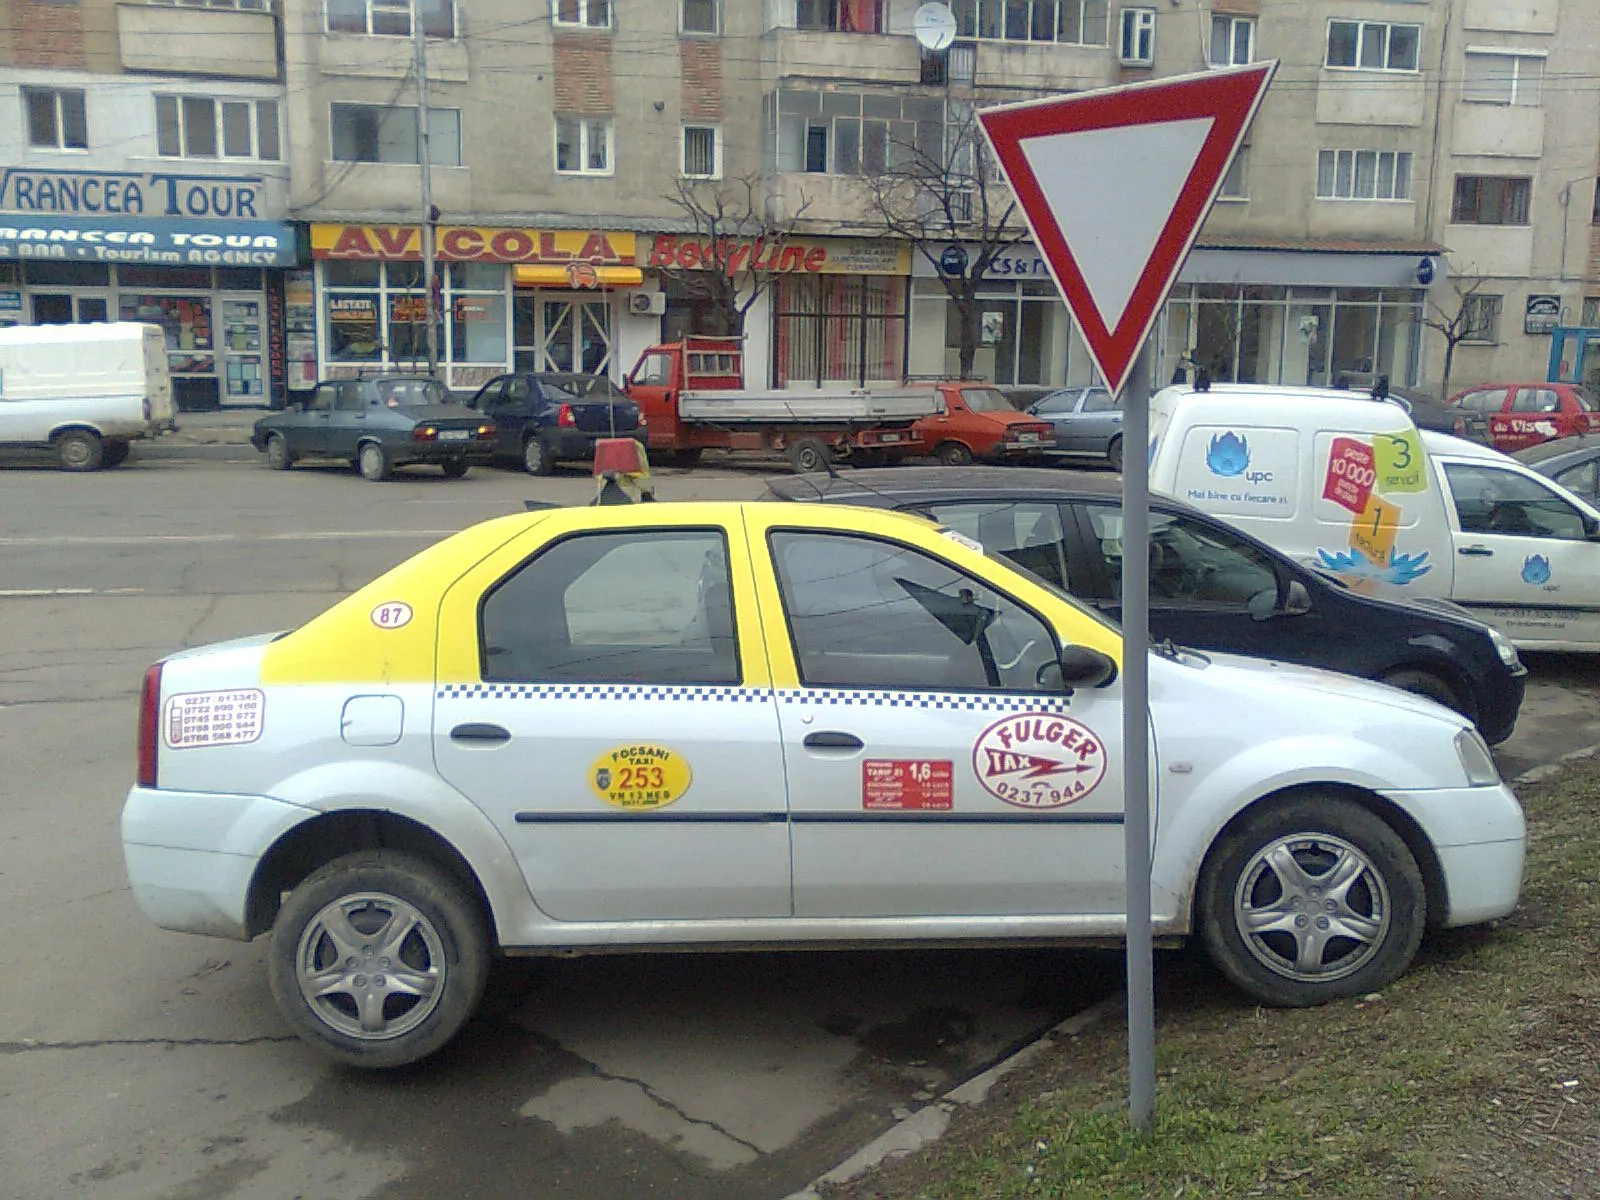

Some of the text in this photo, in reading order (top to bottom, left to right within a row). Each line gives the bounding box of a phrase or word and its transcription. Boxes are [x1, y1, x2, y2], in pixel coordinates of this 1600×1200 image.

[150, 174, 263, 217] TOUR
[170, 233, 278, 248] TOUR
[328, 224, 621, 263] AVICOLA
[1392, 438, 1411, 470] 3
[1246, 472, 1274, 485] upc
[1372, 507, 1383, 537] 1
[380, 607, 403, 624] 87
[997, 719, 1097, 761] FULGER
[619, 766, 664, 789] 253
[996, 780, 1086, 804] 0237 944
